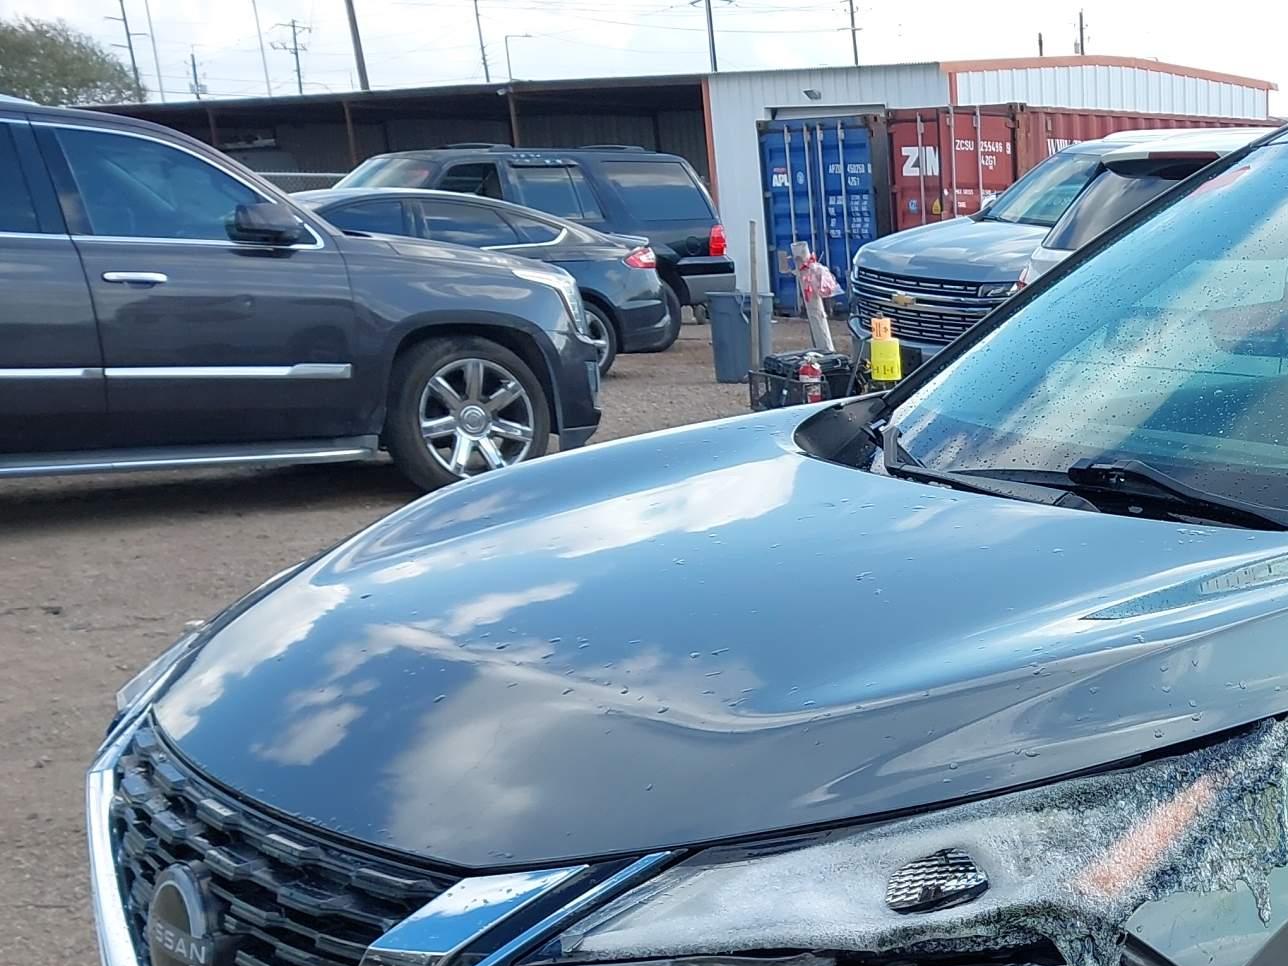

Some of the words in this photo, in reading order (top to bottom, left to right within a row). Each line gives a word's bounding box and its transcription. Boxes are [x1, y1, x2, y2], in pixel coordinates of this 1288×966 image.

[955, 139, 974, 151] ZCSU
[772, 174, 790, 187] APL
[155, 922, 206, 964] SSAN
